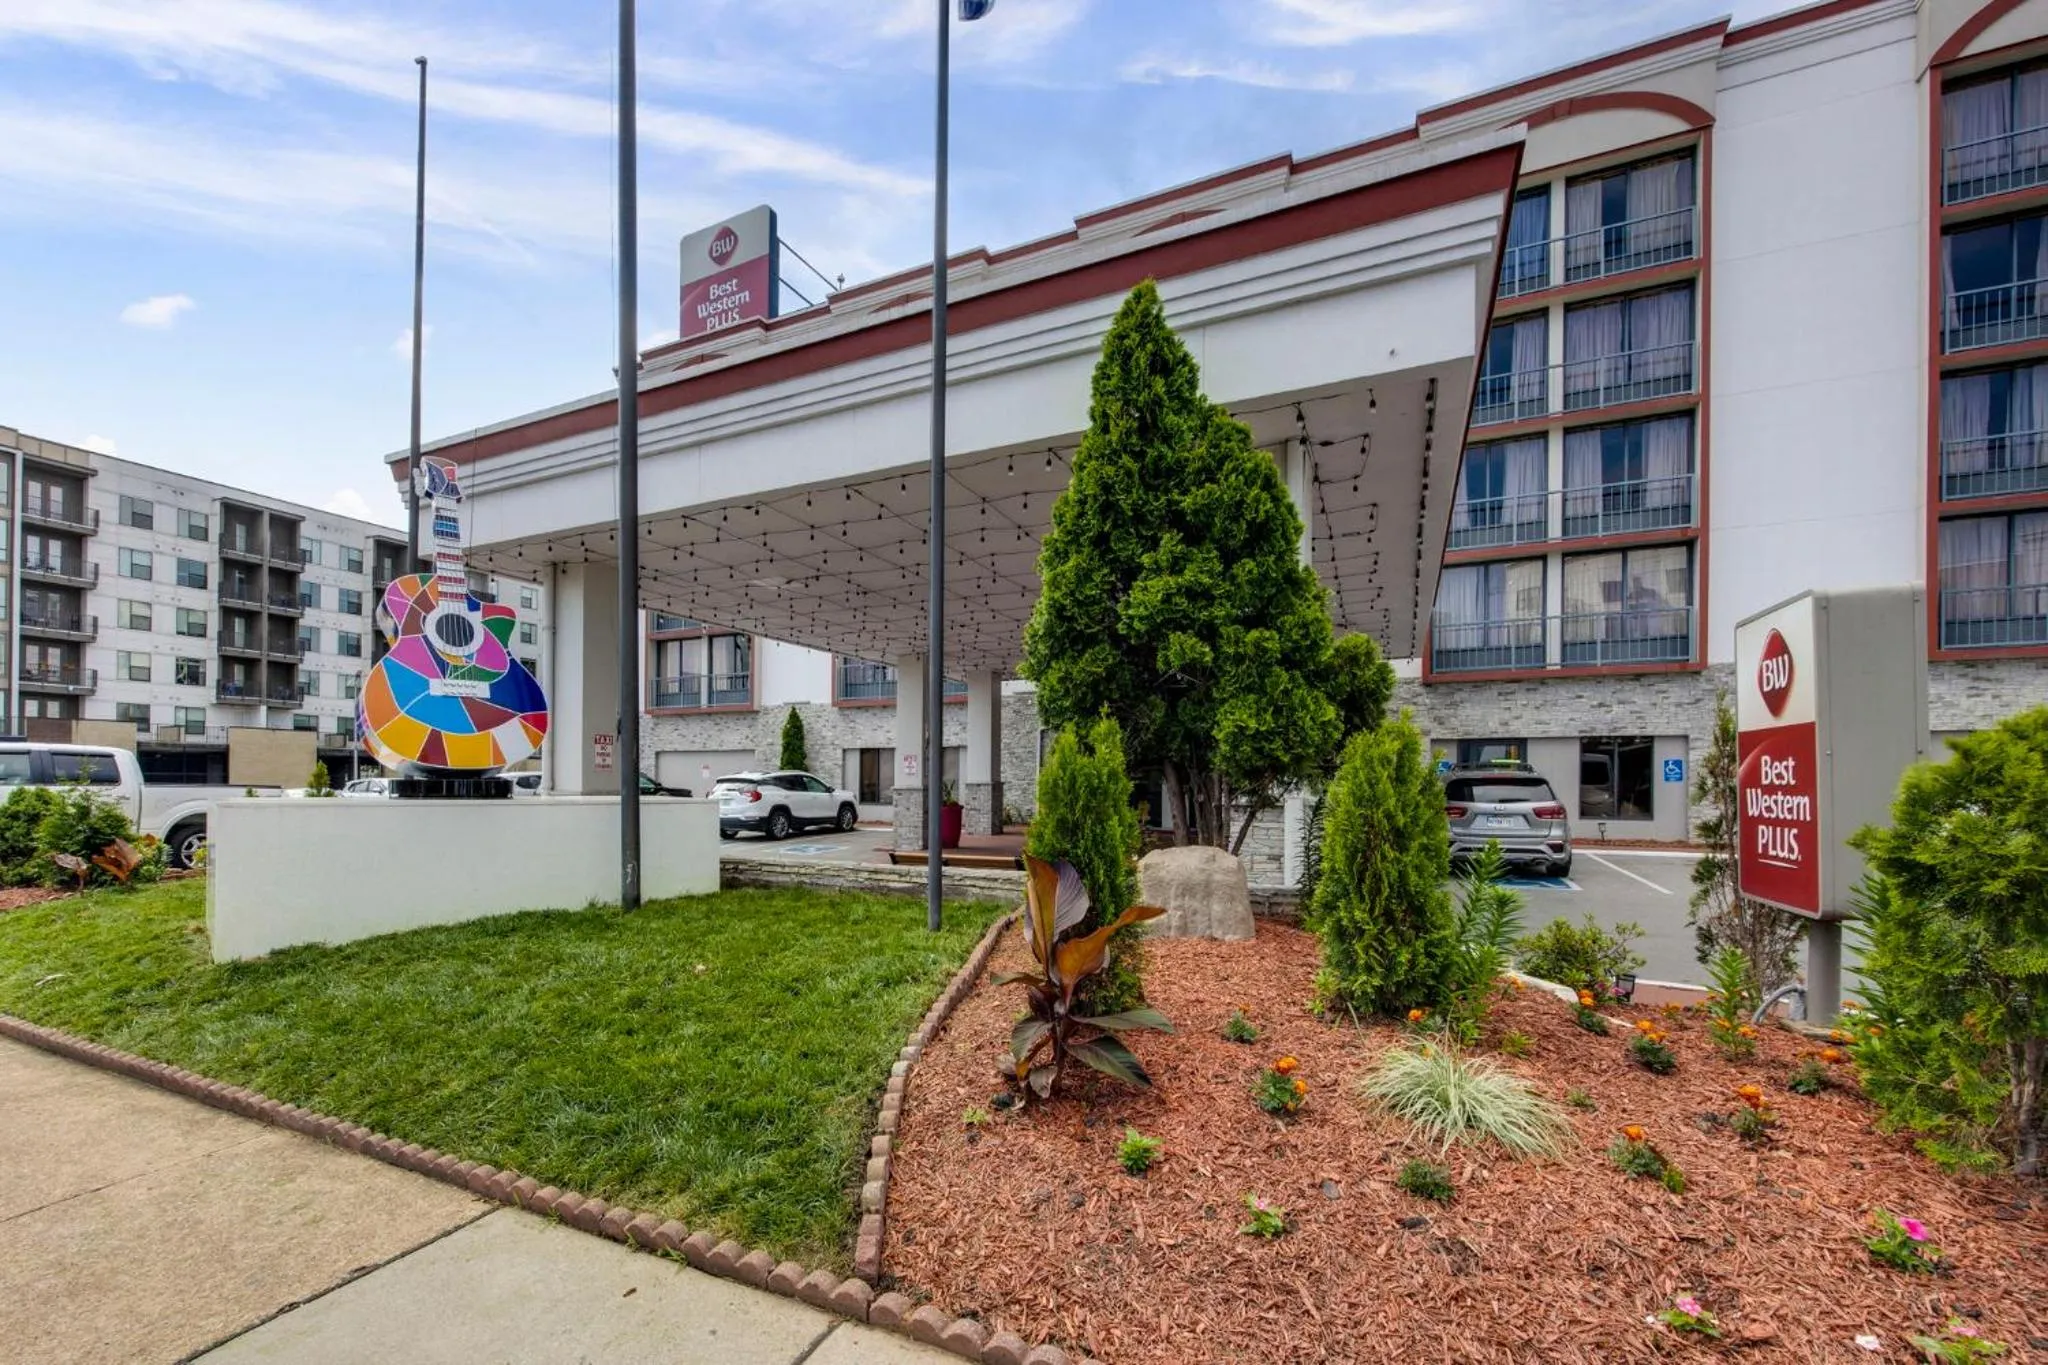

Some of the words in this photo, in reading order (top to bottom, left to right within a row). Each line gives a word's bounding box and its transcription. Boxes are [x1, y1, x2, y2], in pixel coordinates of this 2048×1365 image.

[712, 235, 734, 257] BW
[709, 278, 738, 299] Best
[697, 290, 750, 318] Western
[706, 308, 740, 331] PLUS
[1762, 653, 1790, 692] BW
[1761, 755, 1796, 785] Best
[1746, 788, 1811, 821] Western
